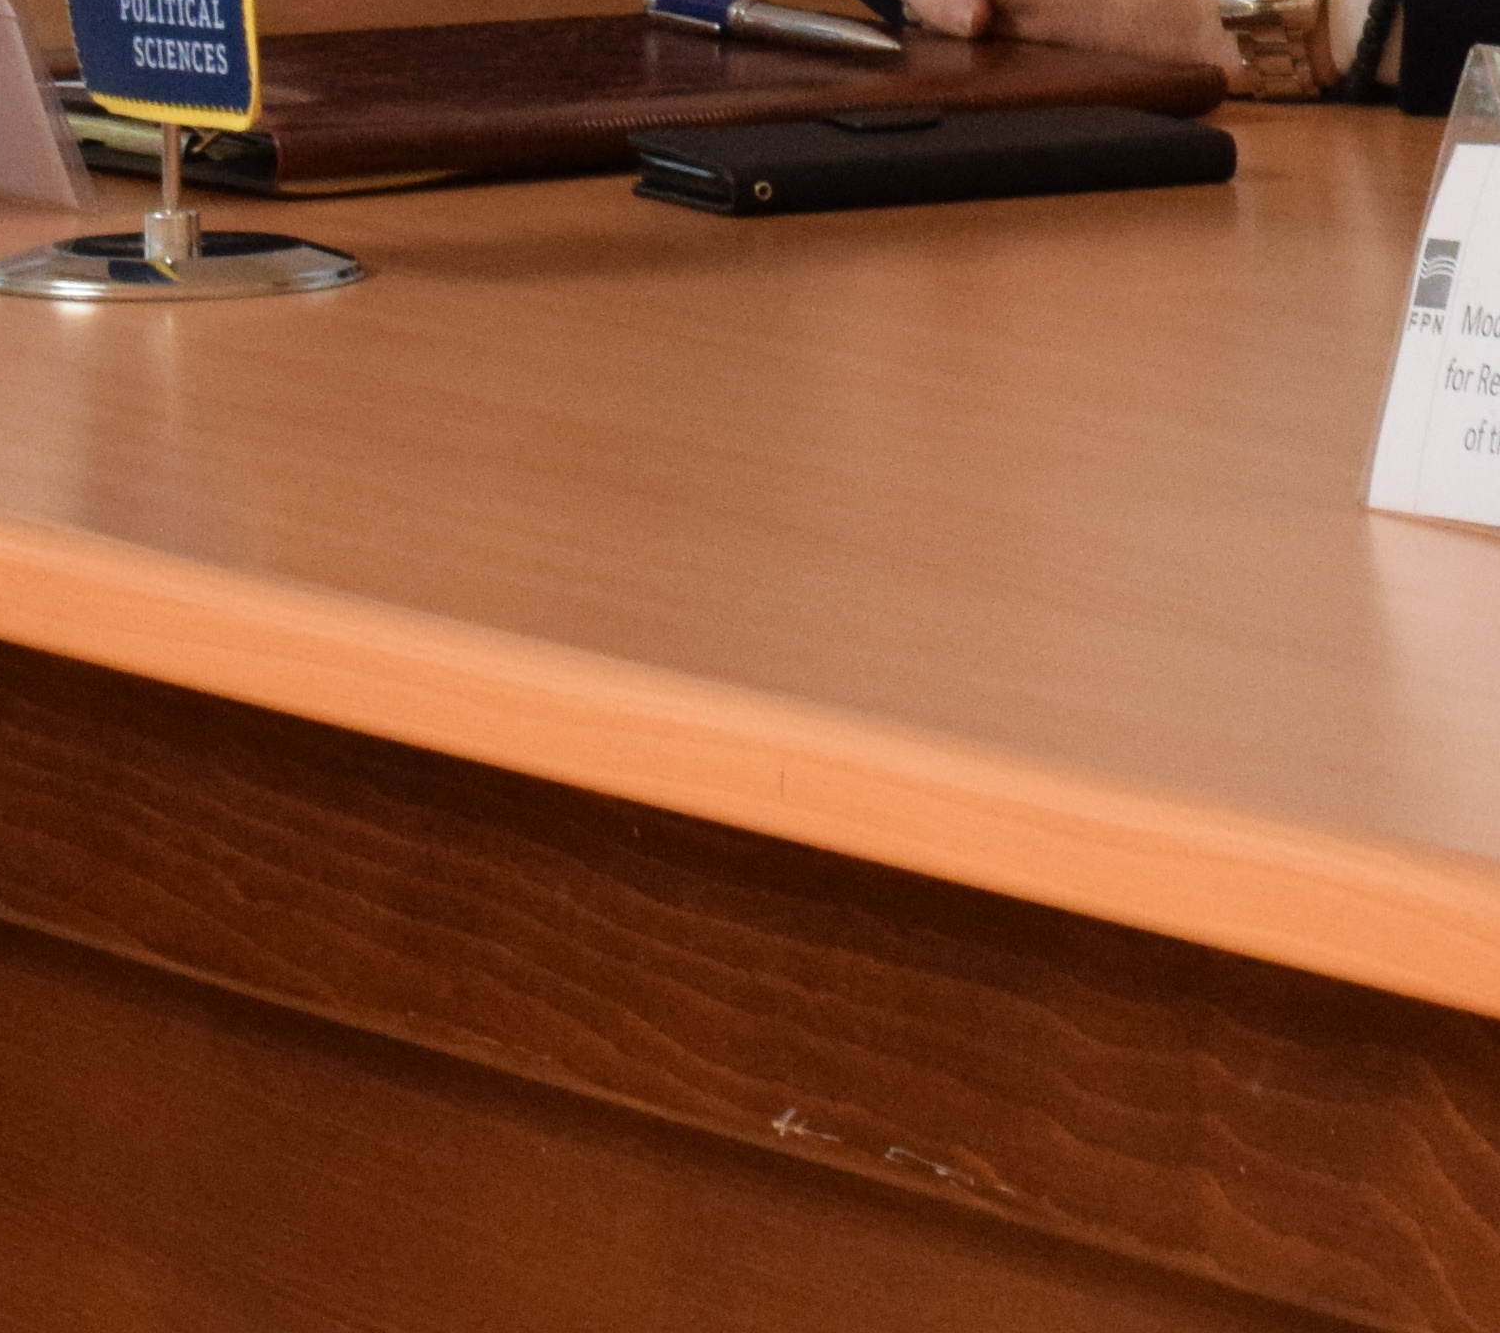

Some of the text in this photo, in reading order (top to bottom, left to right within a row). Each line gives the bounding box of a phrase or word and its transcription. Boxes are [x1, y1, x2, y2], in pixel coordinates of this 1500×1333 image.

[133, 36, 229, 75] SCIENCES
[1407, 312, 1445, 334] FPN
[1444, 357, 1474, 393] for
[1464, 419, 1488, 453] of
